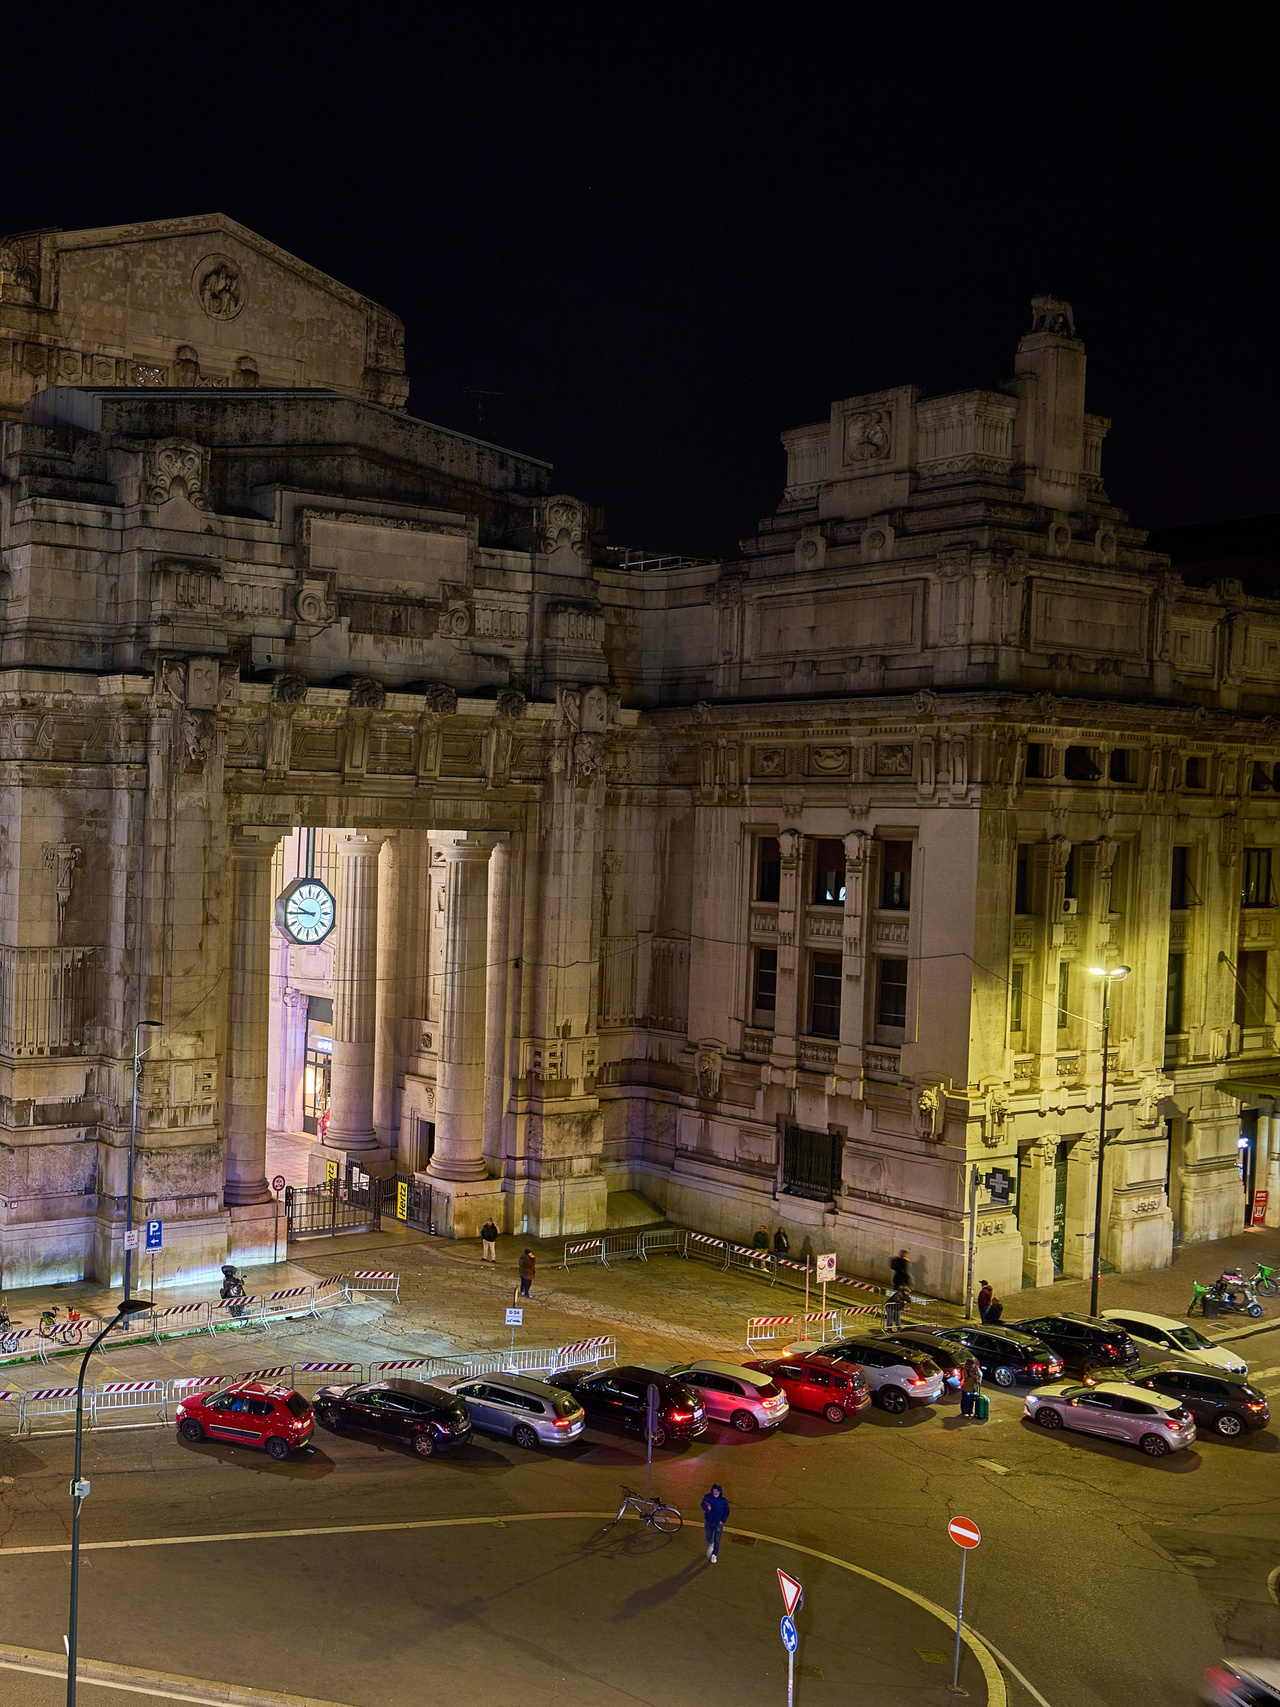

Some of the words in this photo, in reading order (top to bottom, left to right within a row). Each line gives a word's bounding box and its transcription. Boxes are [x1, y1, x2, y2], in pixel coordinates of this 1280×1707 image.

[194, 668, 213, 691] FS
[398, 1184, 407, 1218] Hertz
[150, 1222, 159, 1236] P
